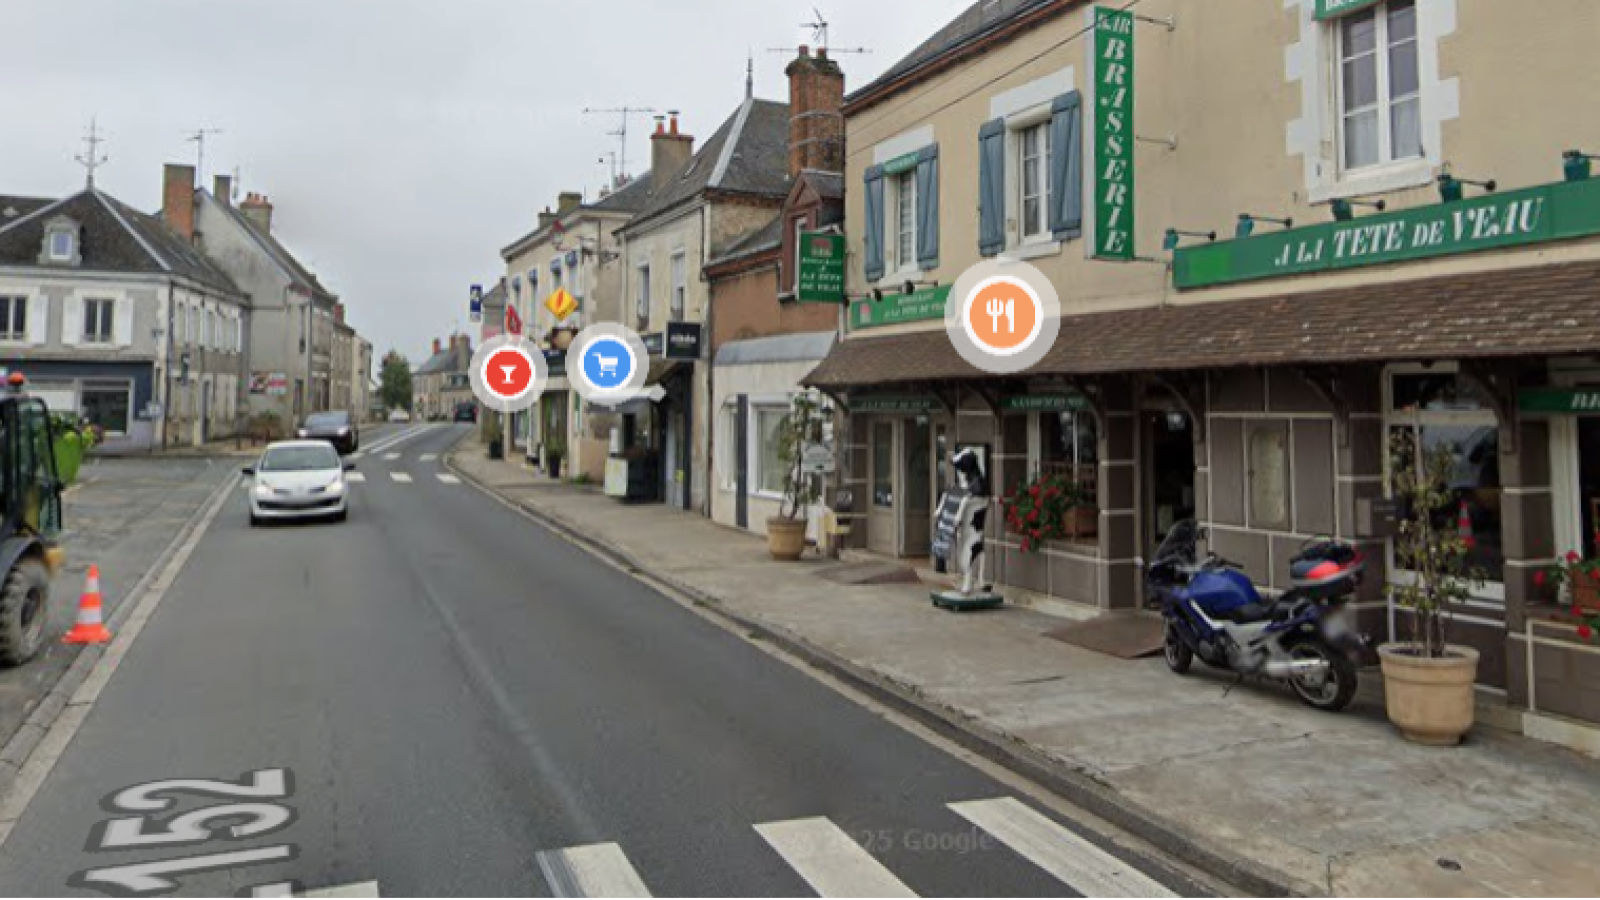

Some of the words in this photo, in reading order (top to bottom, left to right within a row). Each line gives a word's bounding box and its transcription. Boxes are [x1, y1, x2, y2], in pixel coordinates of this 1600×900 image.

[1100, 38, 1128, 254] BRASSERIE
[1274, 243, 1291, 267] A
[1296, 238, 1325, 262] LA
[1332, 220, 1405, 258] TETE
[1411, 219, 1446, 248] DE
[1452, 197, 1544, 242] VEAU
